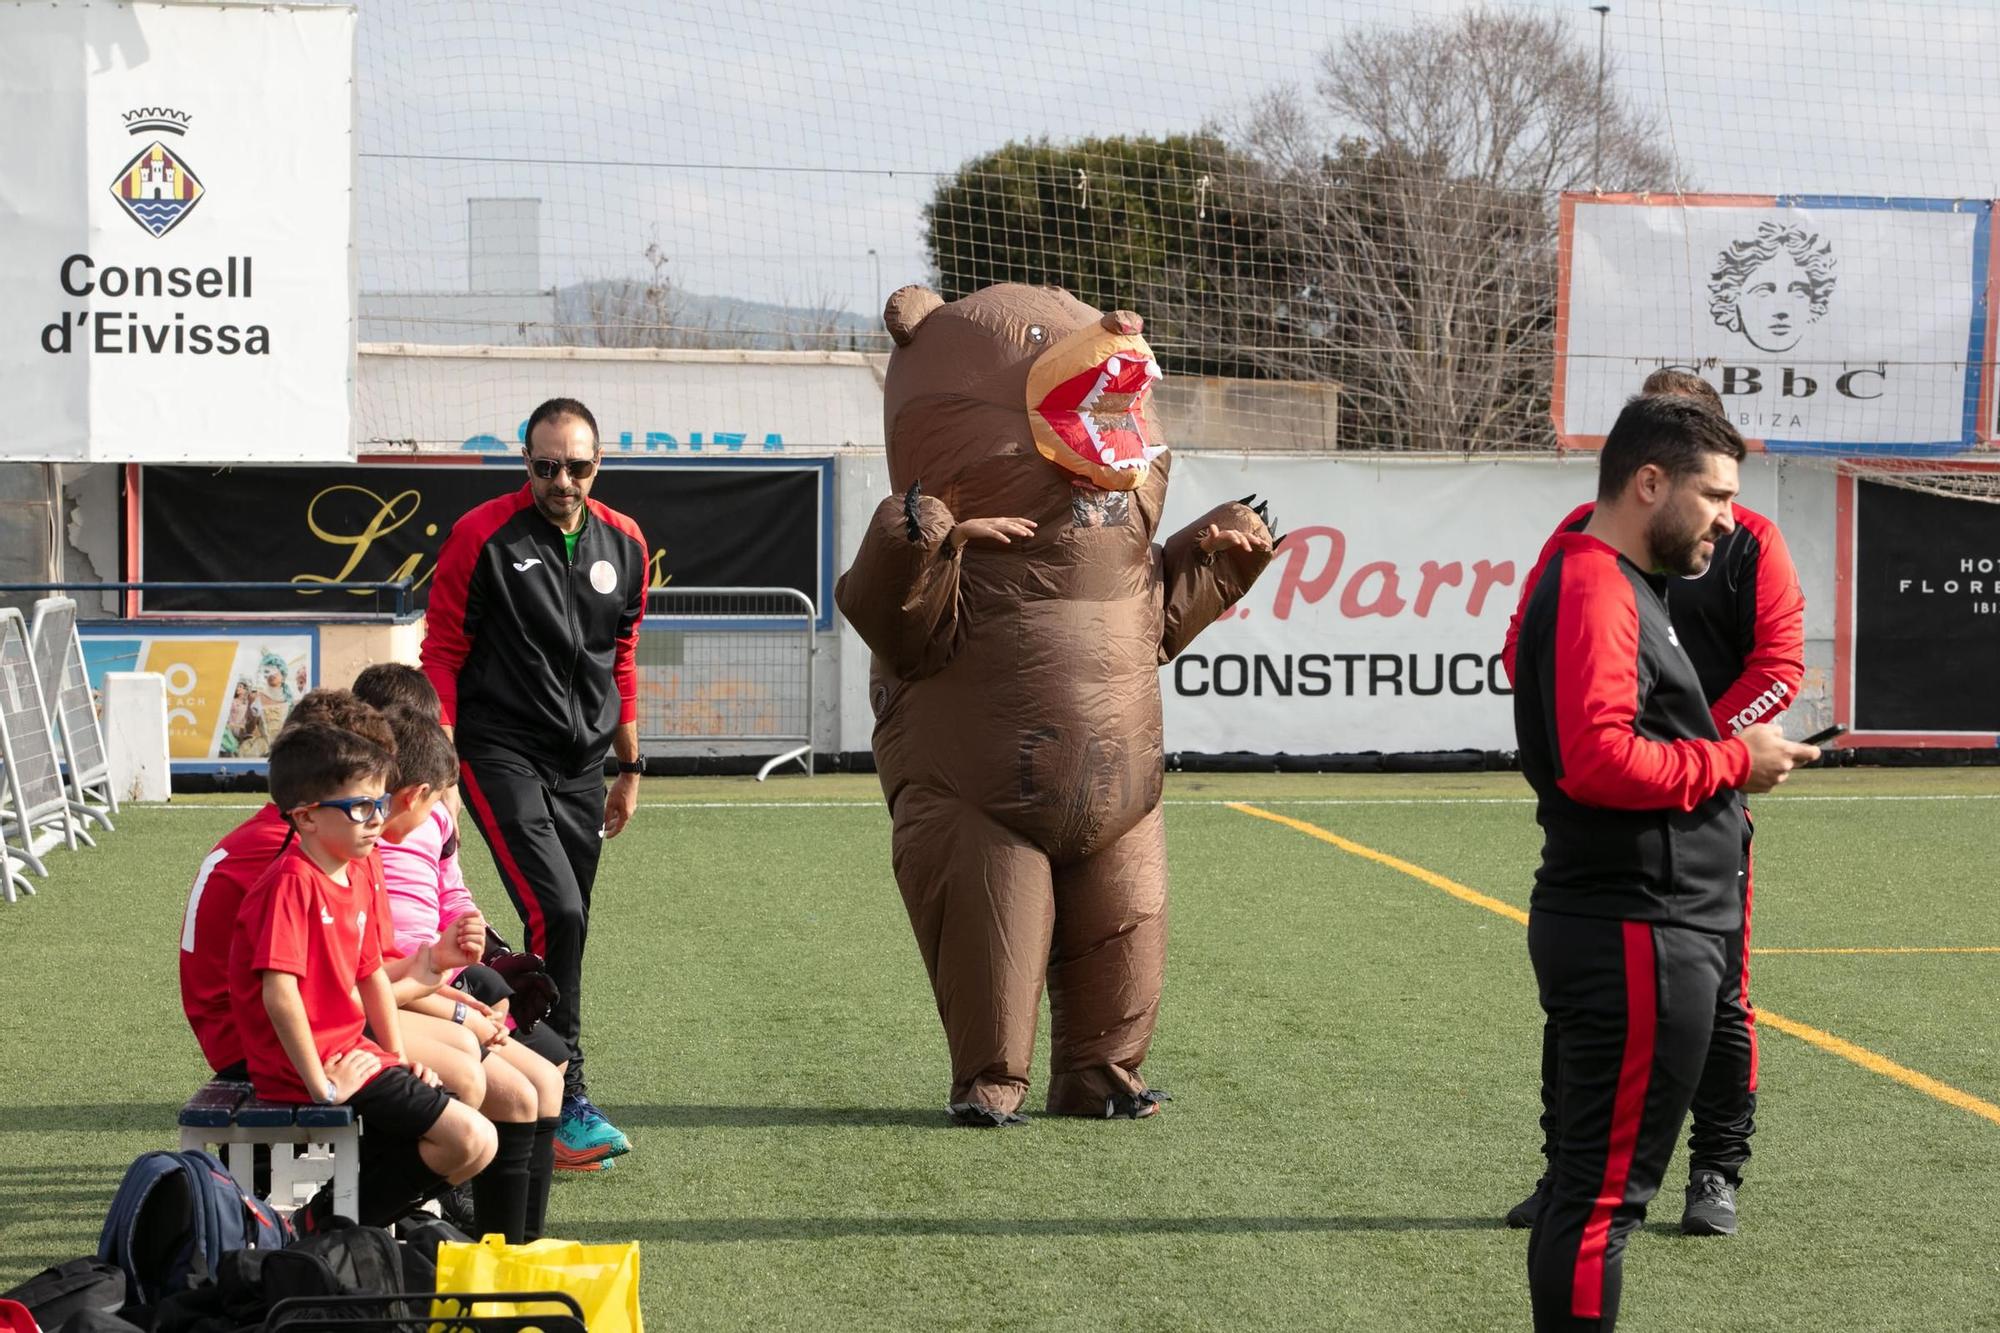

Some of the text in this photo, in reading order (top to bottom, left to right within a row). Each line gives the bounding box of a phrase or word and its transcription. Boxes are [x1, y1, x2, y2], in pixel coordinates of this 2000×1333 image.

[60, 253, 252, 298] Consell
[41, 311, 270, 355] d'Eivissa
[1660, 363, 1886, 400] BbC
[1272, 525, 1529, 620] Parr
[1960, 558, 2000, 573] HO
[1973, 602, 2000, 614] IBI
[1727, 681, 1789, 736] Joma
